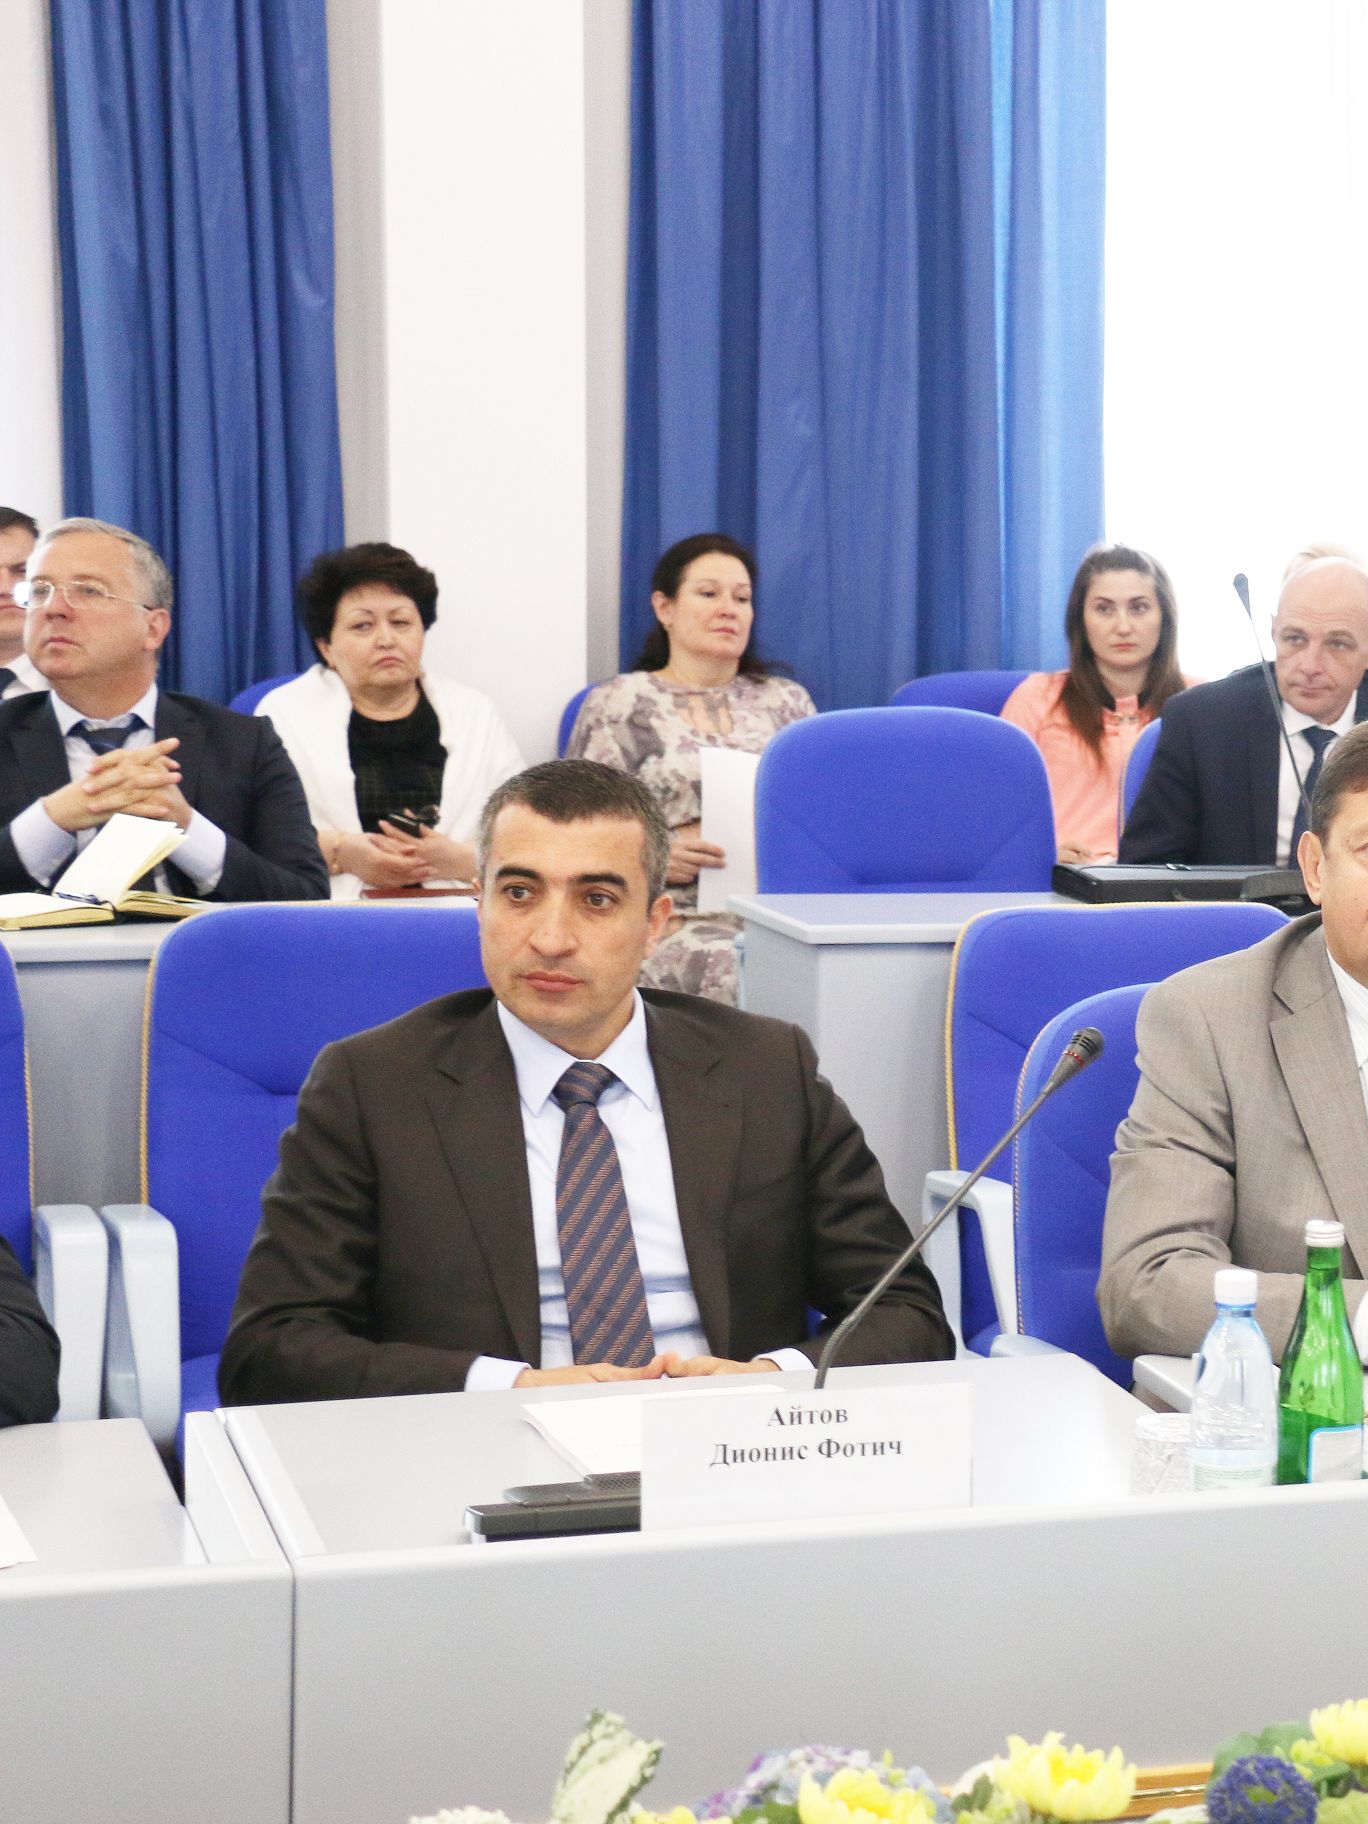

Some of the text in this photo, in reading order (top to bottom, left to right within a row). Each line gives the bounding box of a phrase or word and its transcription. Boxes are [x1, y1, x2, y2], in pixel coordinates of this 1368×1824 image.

[766, 1404, 849, 1427] Айтов
[708, 1438, 902, 1469] Дионис Фотич
